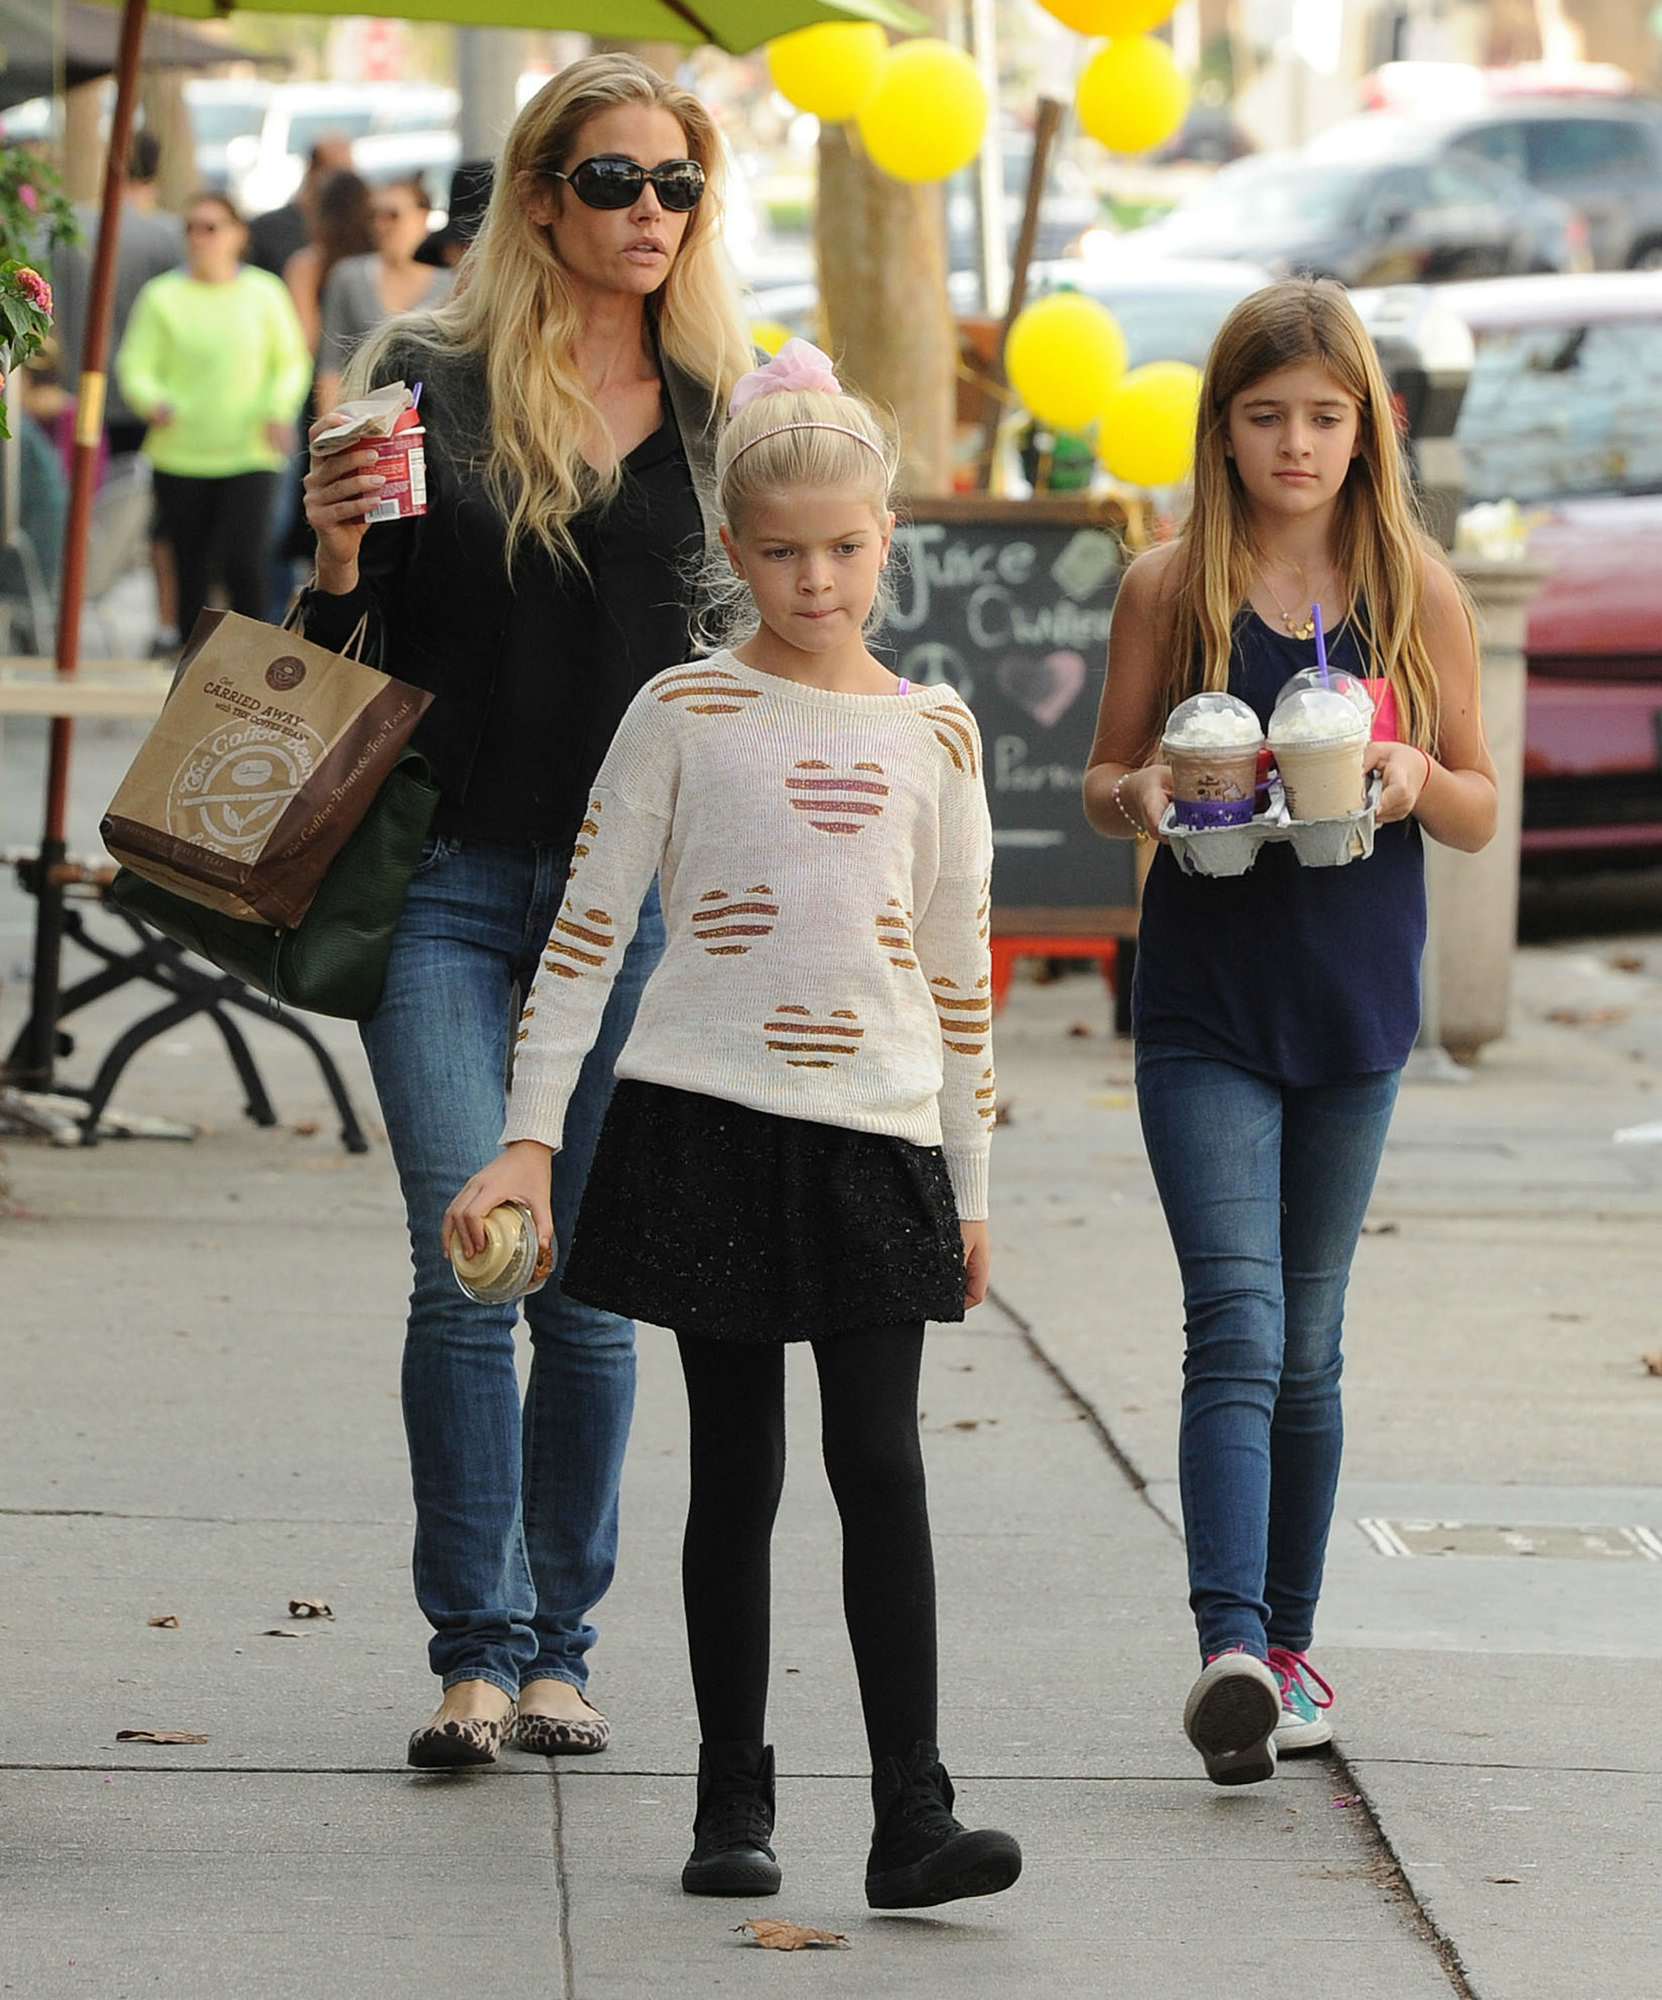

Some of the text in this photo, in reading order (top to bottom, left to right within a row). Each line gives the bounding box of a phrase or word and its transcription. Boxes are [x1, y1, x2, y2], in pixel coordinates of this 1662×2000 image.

[203, 681, 305, 727] CARRIED AWAY
[232, 707, 250, 720] THE
[249, 715, 281, 732] COFFEE
[211, 725, 280, 756] Coffee
[300, 801, 336, 841] Coffee
